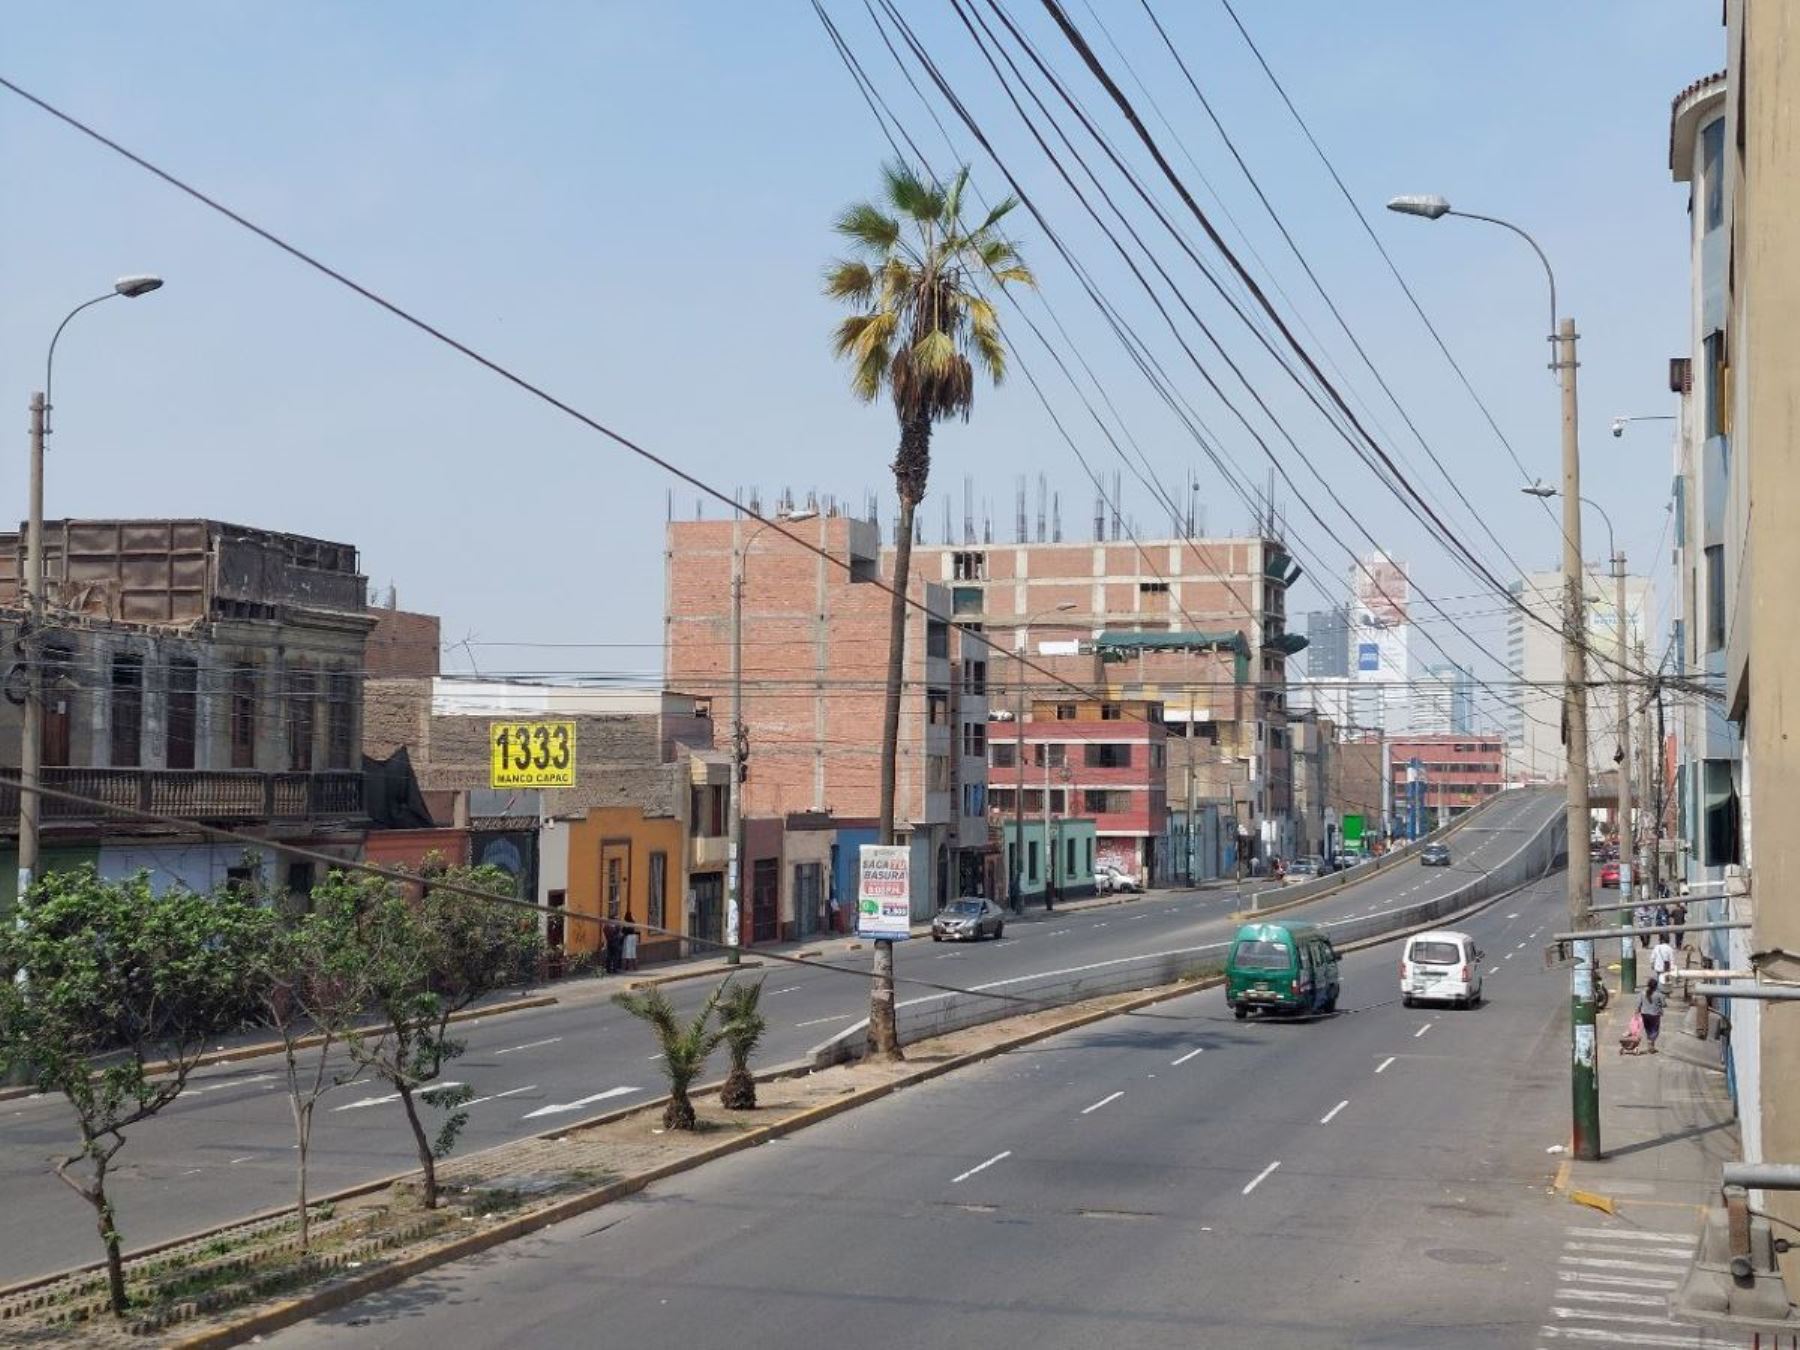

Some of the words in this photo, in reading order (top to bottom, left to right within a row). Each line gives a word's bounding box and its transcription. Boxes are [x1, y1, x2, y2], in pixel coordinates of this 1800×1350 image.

[496, 726, 569, 770] 1333
[497, 773, 533, 783] MANCO
[536, 773, 569, 782] CAPAC
[864, 870, 905, 880] BASURA
